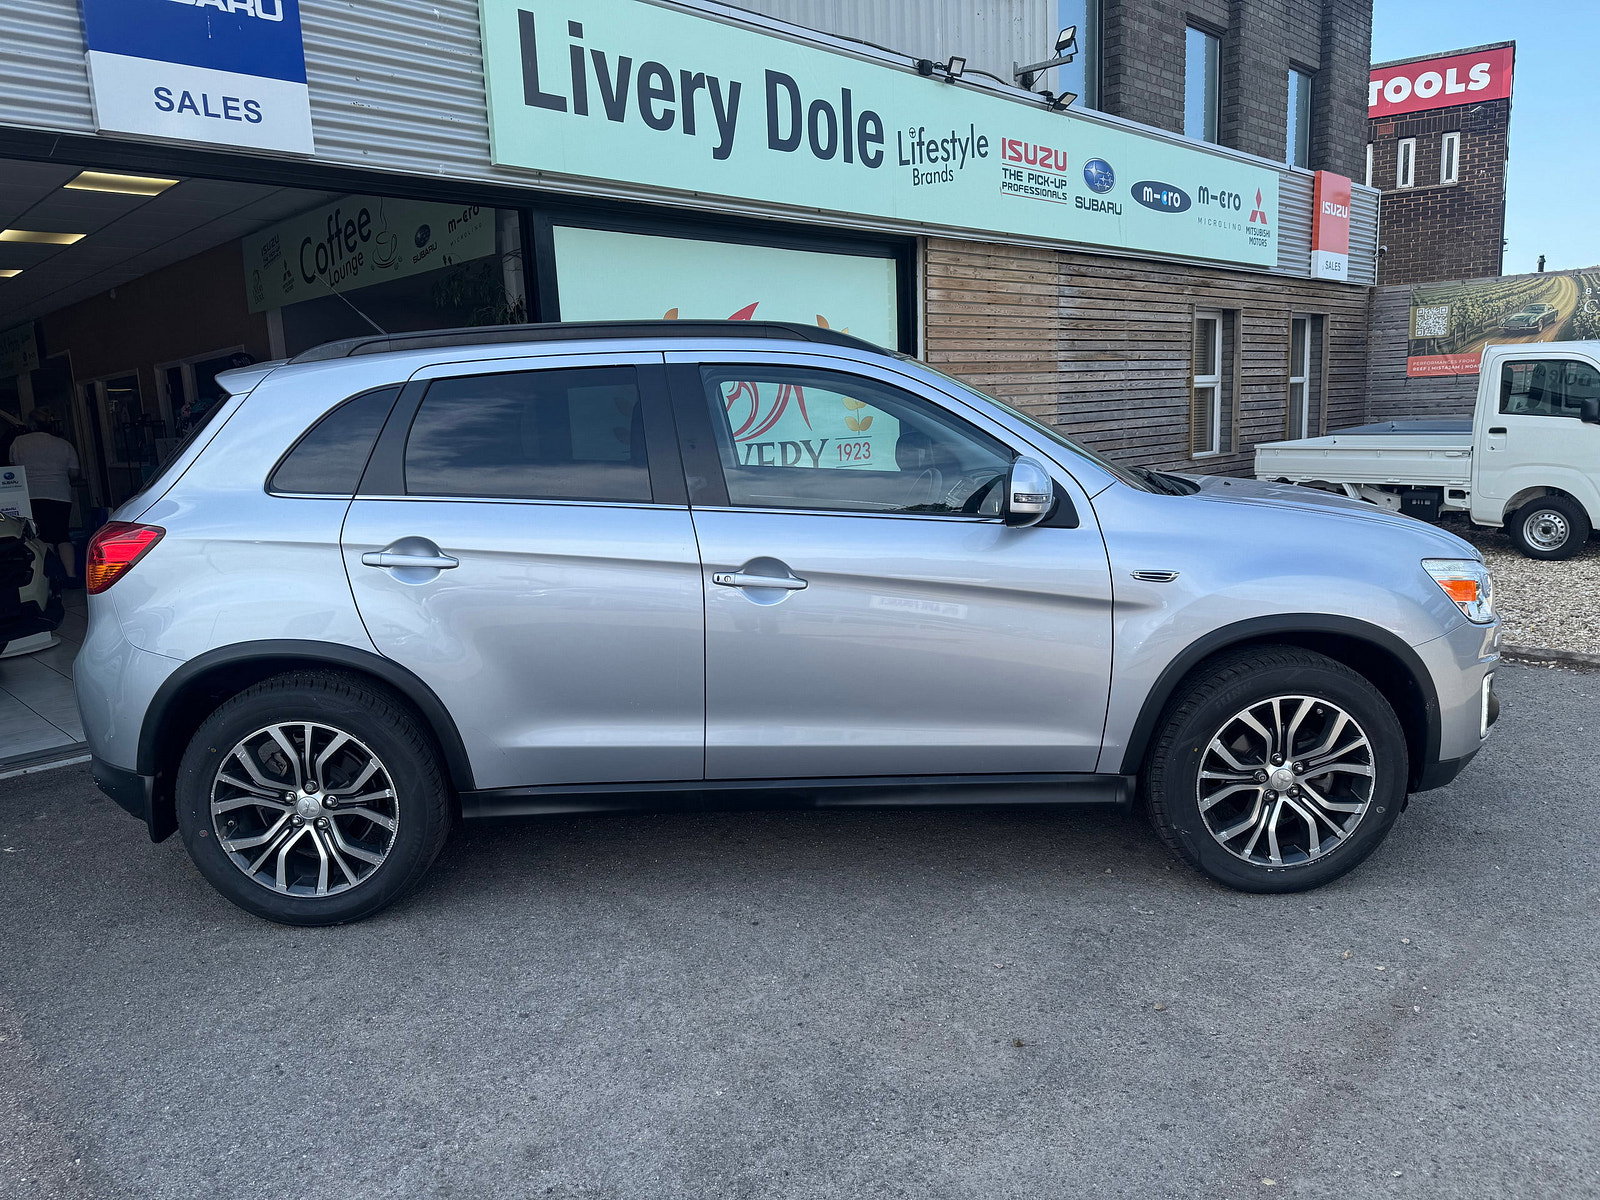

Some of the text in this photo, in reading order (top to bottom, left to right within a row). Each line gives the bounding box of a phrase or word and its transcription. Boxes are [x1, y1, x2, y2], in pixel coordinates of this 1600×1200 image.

[517, 8, 885, 169] Livery Dole
[1368, 62, 1491, 107] TOOLS
[154, 86, 263, 125] SALES
[897, 123, 989, 170] Lifestyle
[1001, 137, 1068, 172] ISUZU
[912, 164, 954, 187] Brands
[1002, 168, 1068, 190] THE PICK-UP
[1002, 181, 1068, 201] PROFESSIONALS
[1075, 195, 1122, 216] SUBARU
[1321, 200, 1348, 219] ISUZU
[1197, 217, 1242, 232] MICROLINO
[1245, 225, 1271, 239] MITSUBISHI
[261, 232, 280, 256] ISUZU
[299, 207, 372, 285] Coffee
[411, 241, 438, 265] SUBARU
[1248, 237, 1268, 248] MOTORS
[328, 251, 364, 287] Lounge
[1325, 260, 1342, 272] SALES
[836, 441, 872, 462] 1923
